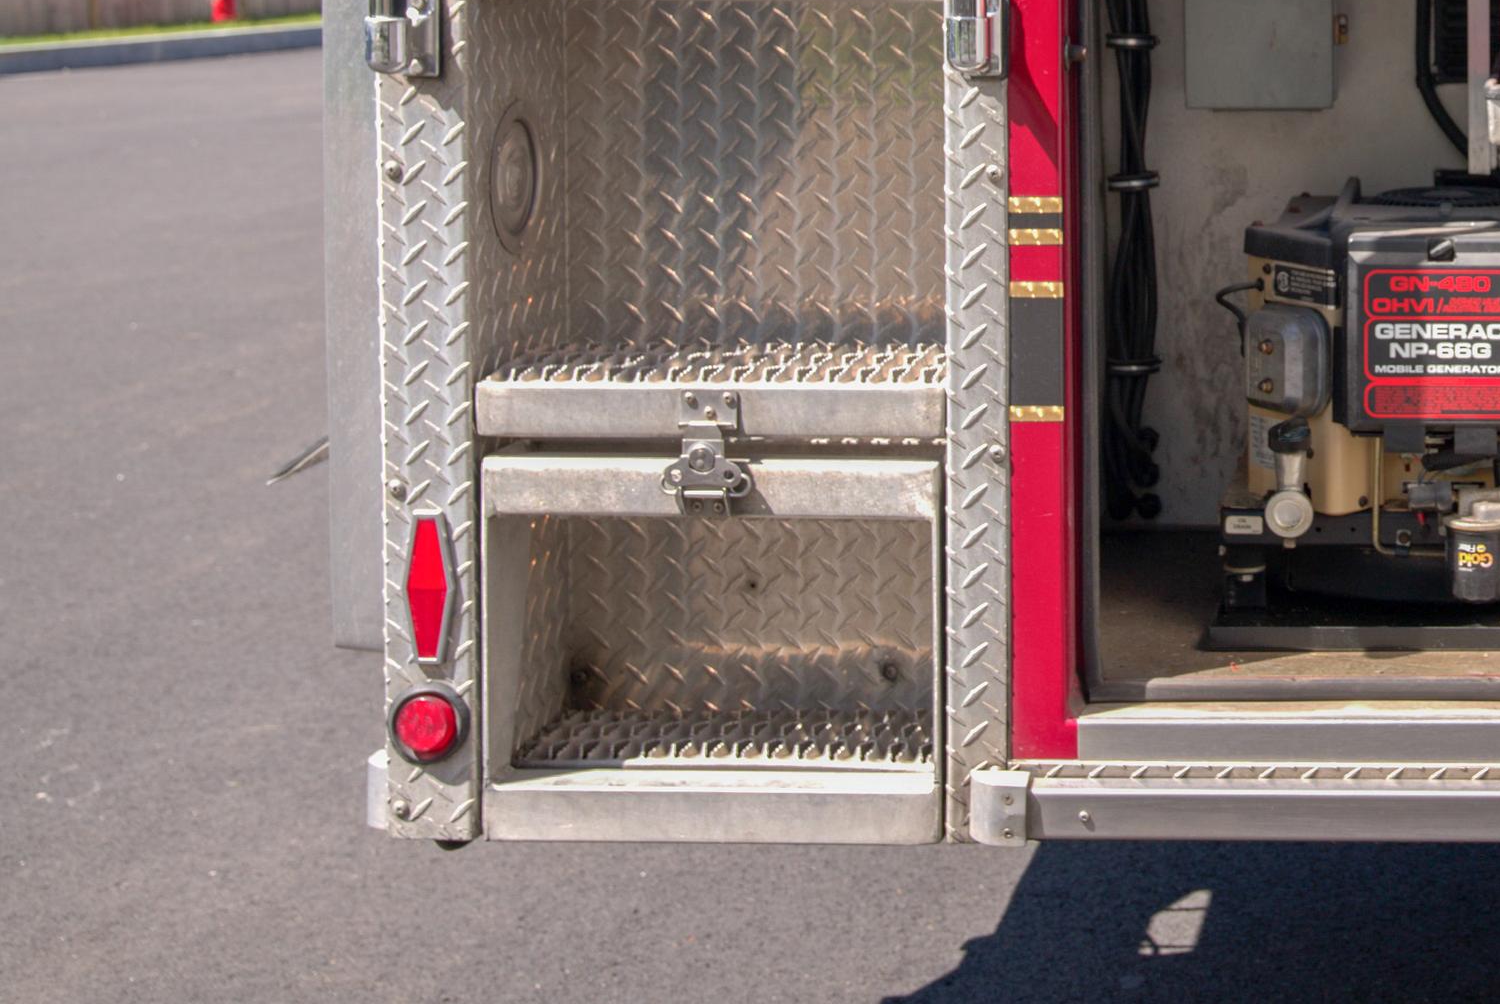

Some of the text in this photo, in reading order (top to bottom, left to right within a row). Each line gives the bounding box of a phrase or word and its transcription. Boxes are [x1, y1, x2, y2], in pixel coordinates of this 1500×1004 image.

[1389, 275, 1491, 293] GN-480
[1389, 342, 1492, 359] NP-66G
[1374, 364, 1424, 374] MOBILE
[1458, 552, 1494, 568] Gold
